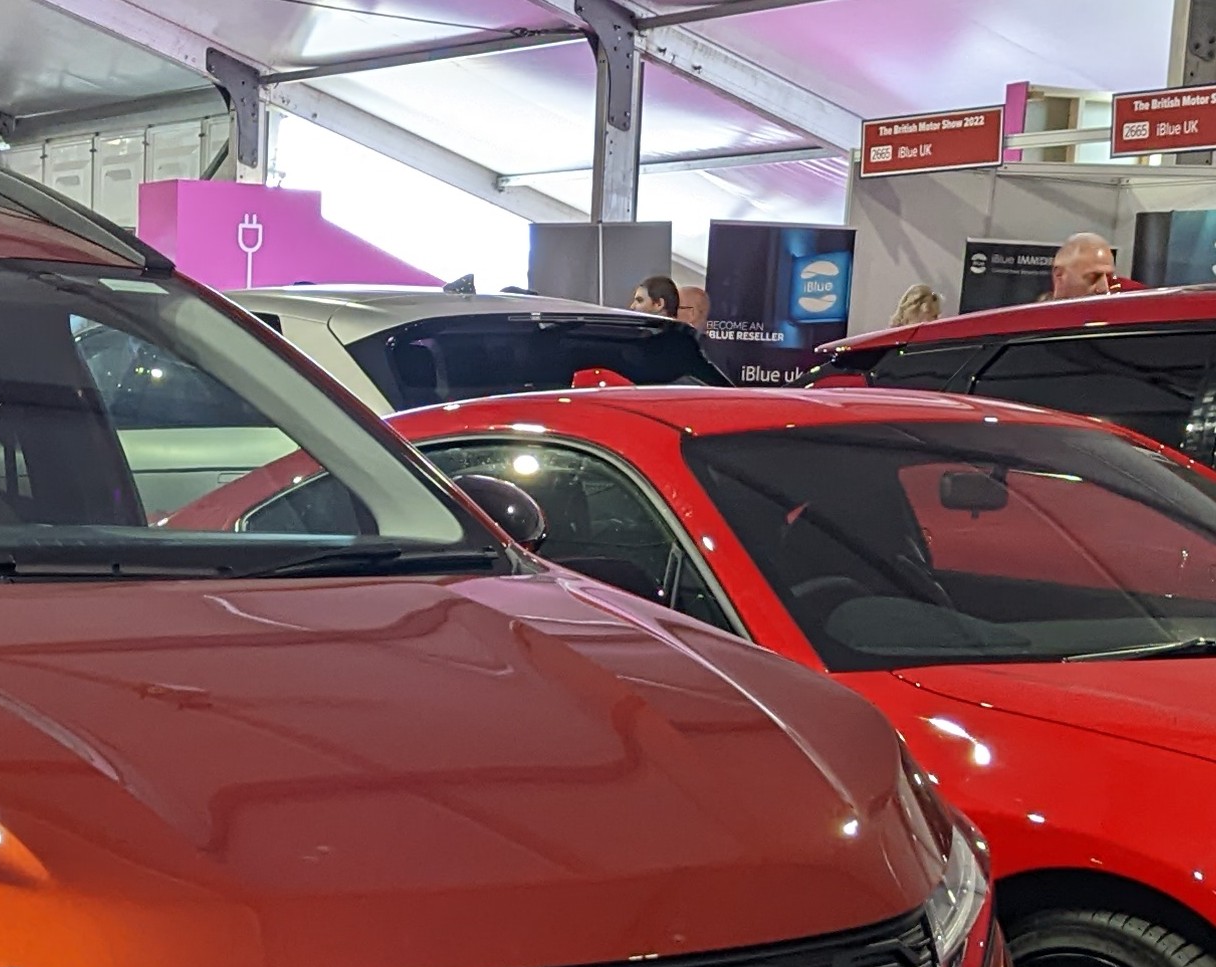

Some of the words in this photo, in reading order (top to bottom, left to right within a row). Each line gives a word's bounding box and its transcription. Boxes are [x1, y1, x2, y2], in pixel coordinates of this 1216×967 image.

[1133, 101, 1150, 112] The
[1151, 97, 1181, 110] British
[1181, 95, 1210, 107] Motor
[879, 126, 893, 137] The
[893, 123, 918, 135] British
[918, 120, 941, 132] Motor
[941, 118, 963, 130] Show
[963, 115, 985, 128] 2022
[1124, 123, 1148, 138] 2665
[1156, 122, 1182, 137] iBlue
[1183, 120, 1199, 134] UK
[897, 145, 919, 159] iBlue
[919, 144, 933, 157] UK
[803, 281, 834, 293] iBlue
[706, 320, 748, 331] BECOME
[749, 322, 764, 331] AN
[736, 332, 784, 342] RESELLER
[741, 365, 781, 383] iBlue
